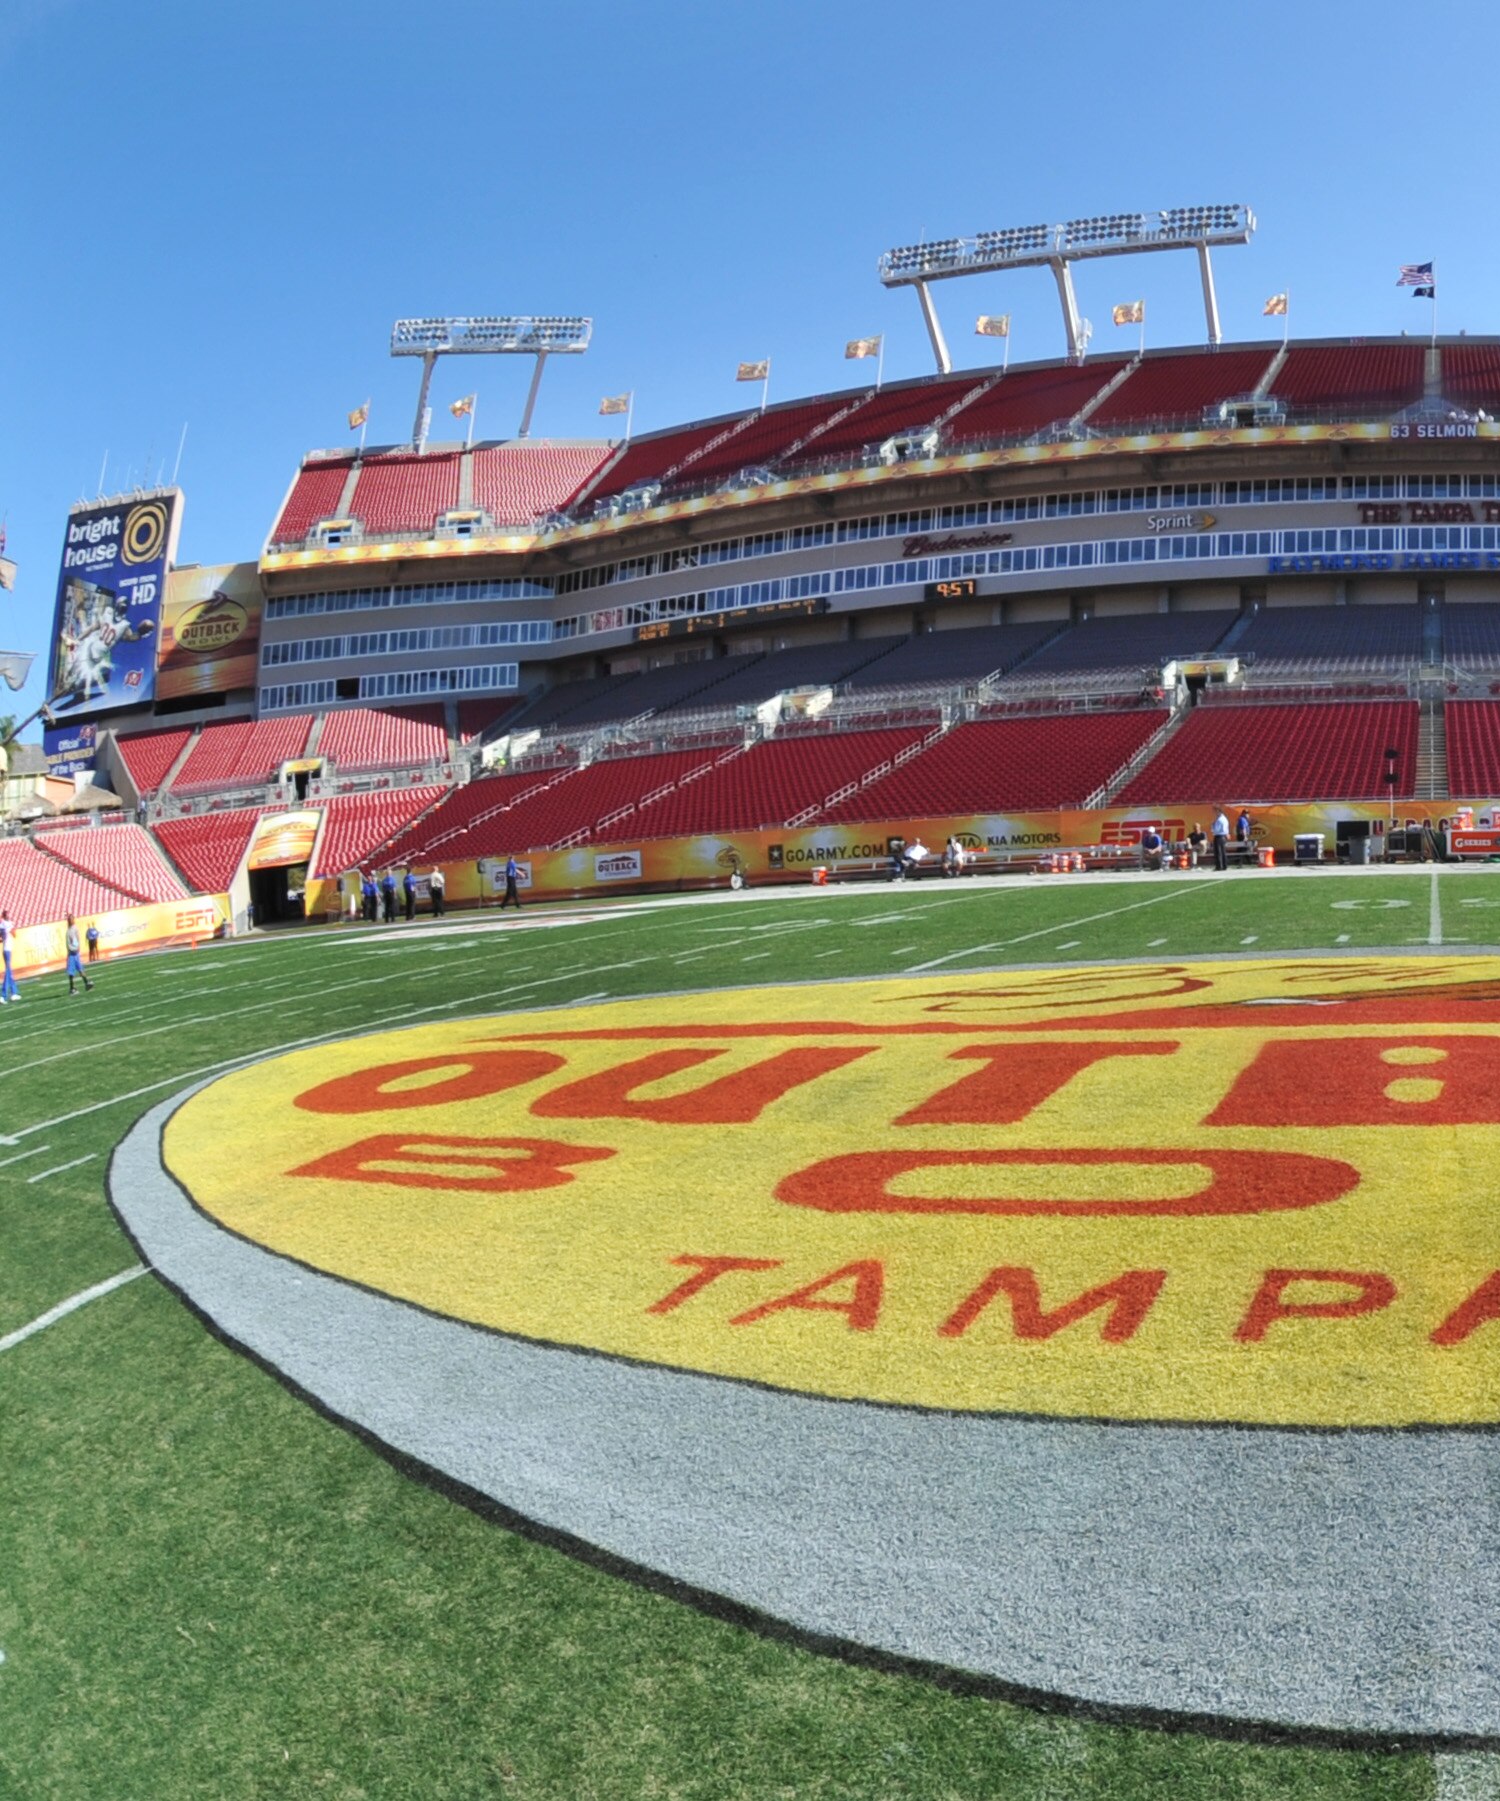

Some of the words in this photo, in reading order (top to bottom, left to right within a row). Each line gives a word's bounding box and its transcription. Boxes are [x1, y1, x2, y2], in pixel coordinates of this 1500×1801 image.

[1391, 424, 1410, 438] 63
[1416, 424, 1477, 438] SELMON
[1147, 513, 1192, 533] Sprint
[1358, 503, 1400, 524] THE
[1406, 502, 1475, 523] TAMPA
[68, 515, 121, 543] bright
[903, 531, 1013, 557] Budweiser
[64, 543, 118, 568] house
[131, 583, 157, 605] HD
[182, 622, 240, 640] OUTBACK
[987, 835, 1008, 847] KIA
[1010, 833, 1062, 845] MOTORS
[1101, 819, 1185, 845] ESPN
[785, 844, 884, 863] GOARMY.COM
[598, 860, 639, 873] OUTBACK
[173, 908, 215, 930] ESPN
